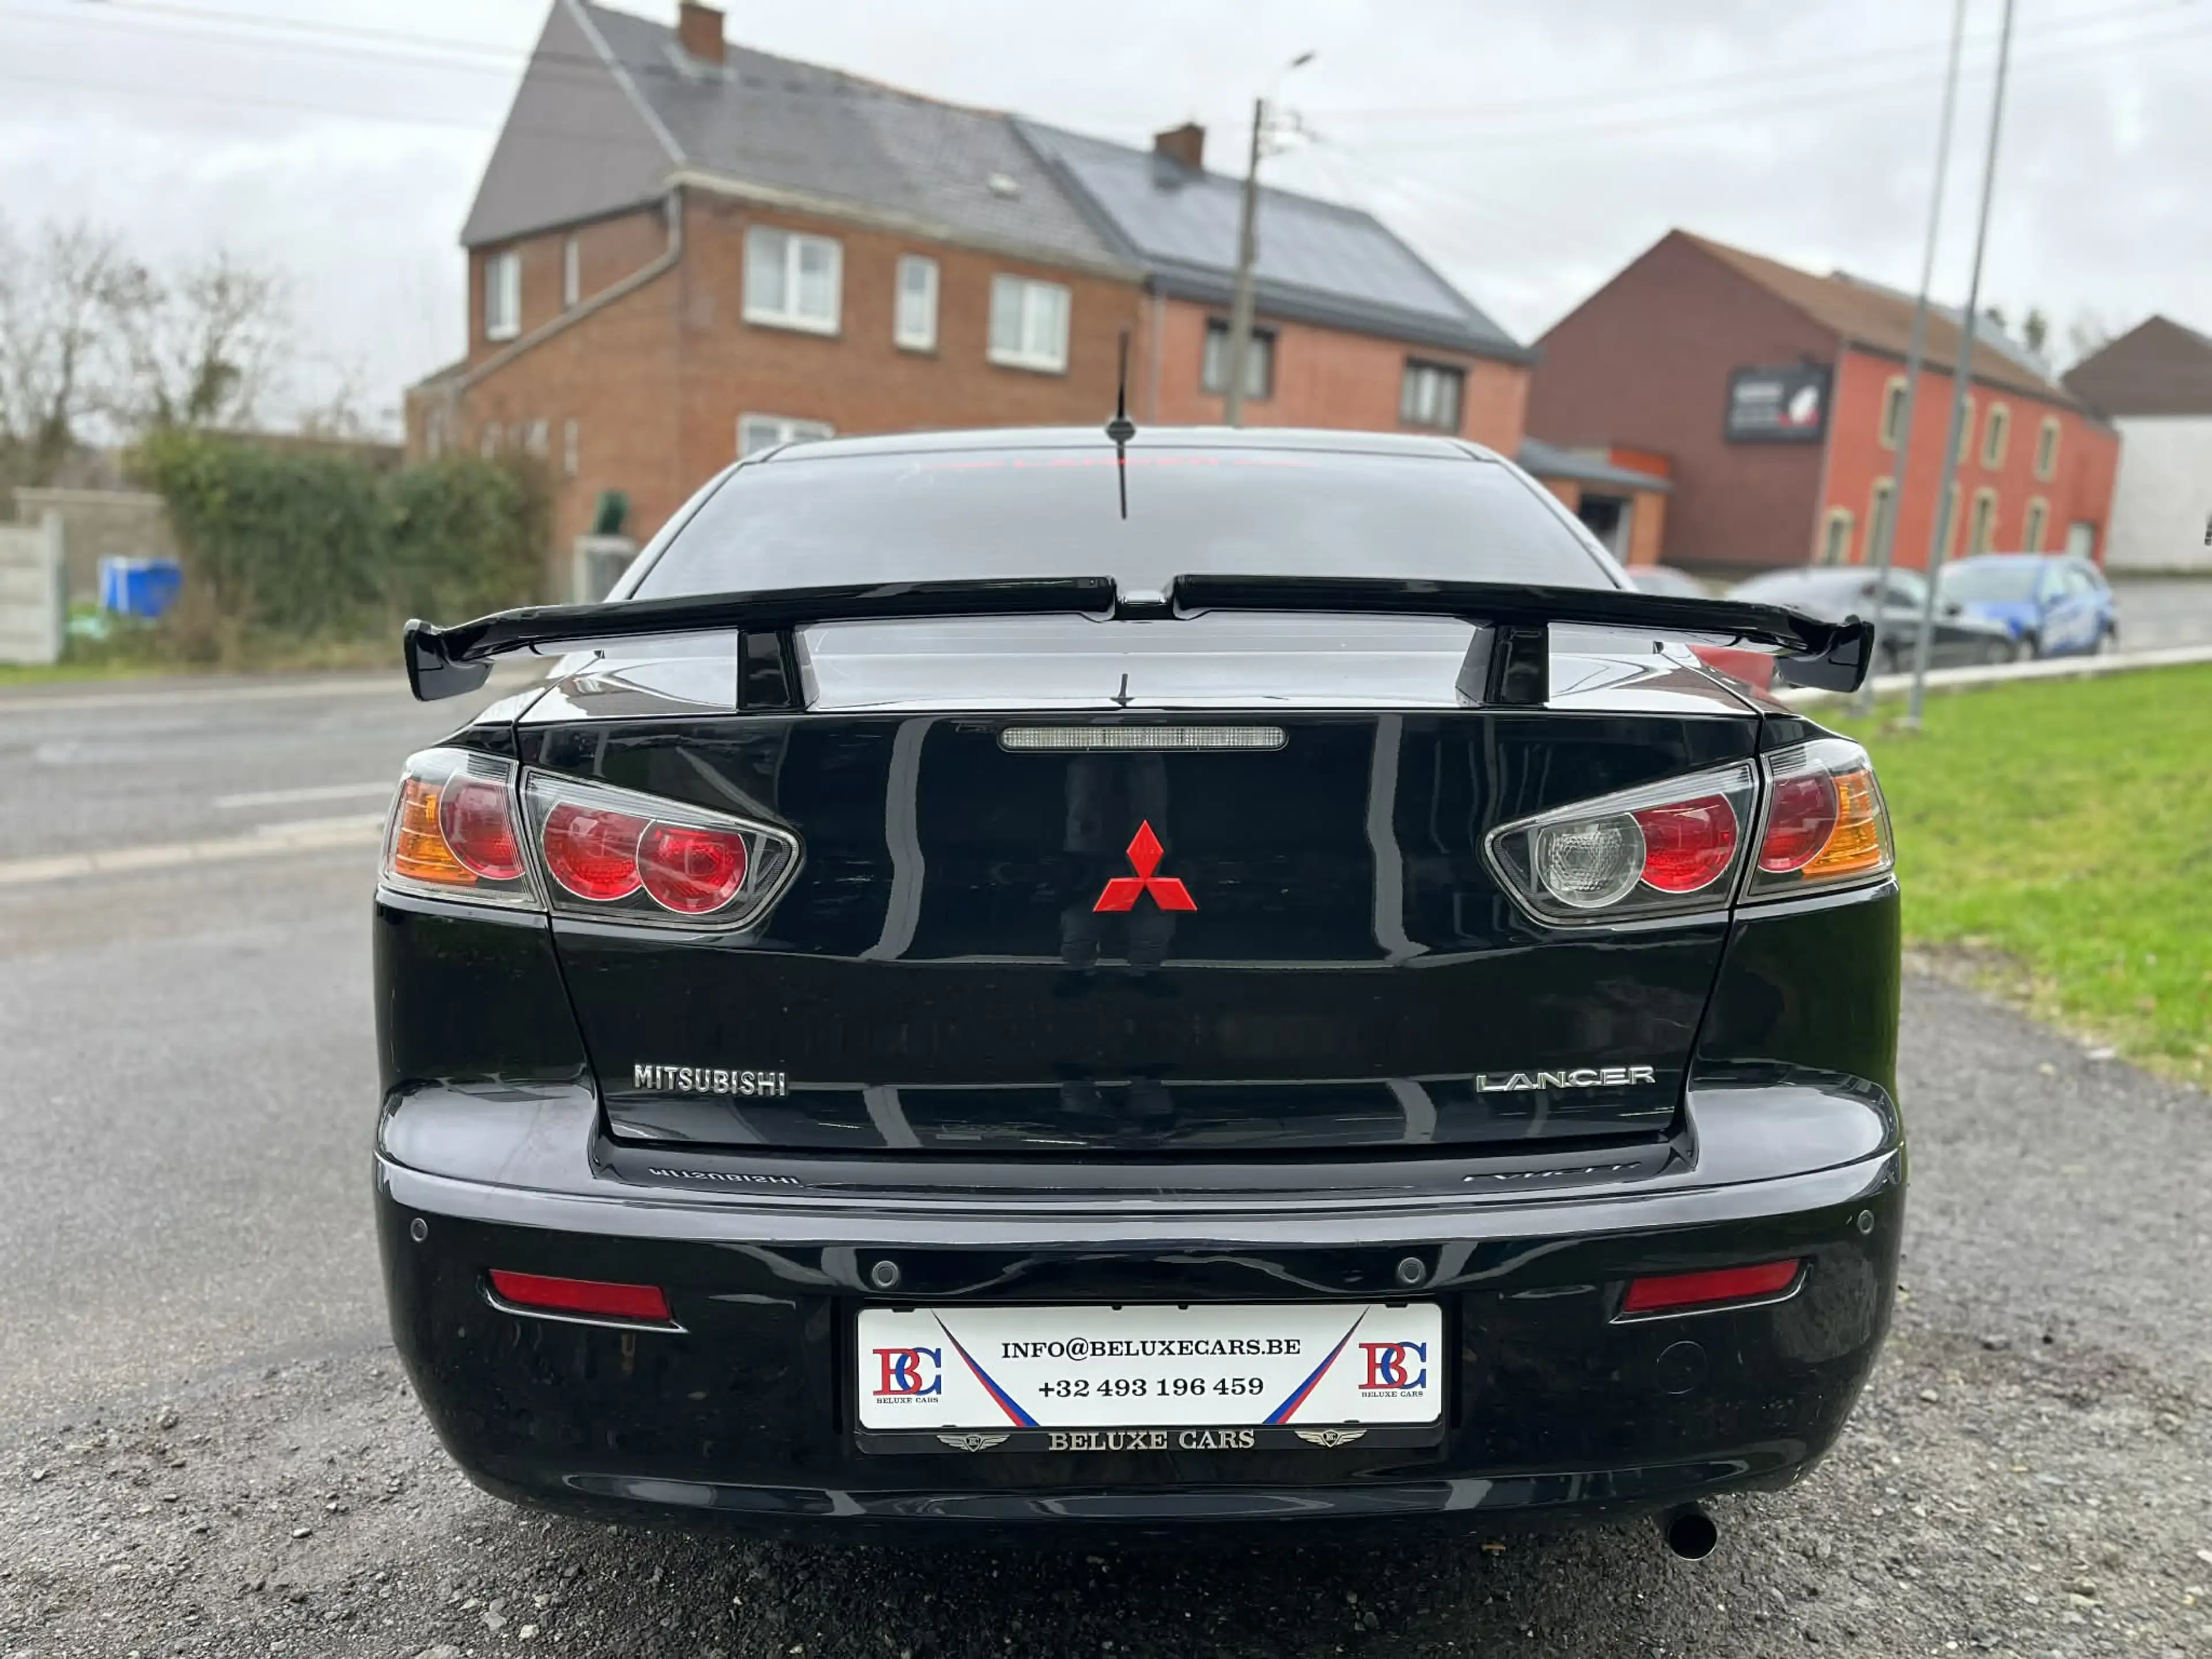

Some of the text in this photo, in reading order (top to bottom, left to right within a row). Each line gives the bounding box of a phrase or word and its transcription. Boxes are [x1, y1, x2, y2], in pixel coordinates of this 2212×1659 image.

[634, 1064, 786, 1097] MITSUBISHI
[1476, 1066, 1656, 1093] LANCER
[1001, 1337, 1301, 1361] INFO@BELUXECARS.BE
[872, 1347, 942, 1396] BC
[1358, 1341, 1427, 1390] BC
[1038, 1377, 1264, 1398] +32 493 196 459
[1048, 1429, 1255, 1451] BELUXE CARS
